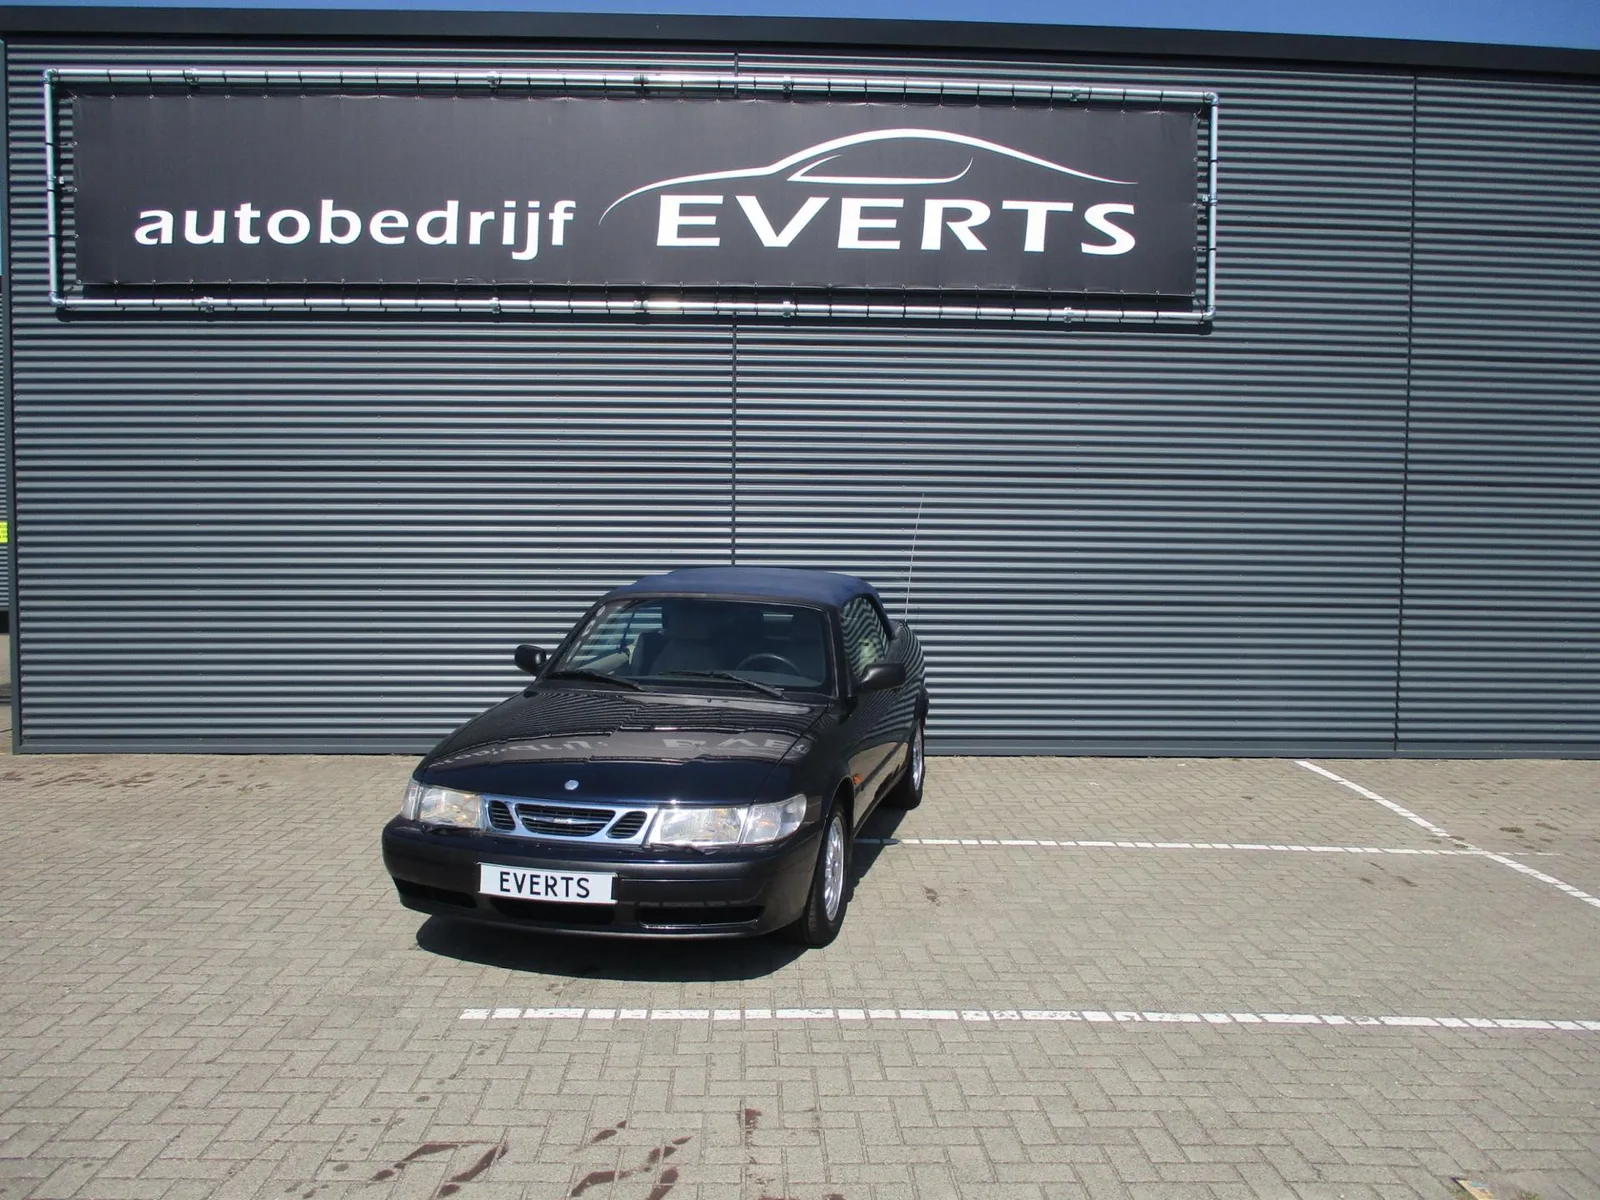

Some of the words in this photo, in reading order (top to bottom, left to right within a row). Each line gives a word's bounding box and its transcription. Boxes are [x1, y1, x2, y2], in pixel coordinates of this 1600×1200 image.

[134, 199, 577, 261] autobedrijf
[656, 194, 1136, 256] EVERTS
[499, 871, 590, 899] EVERTS
